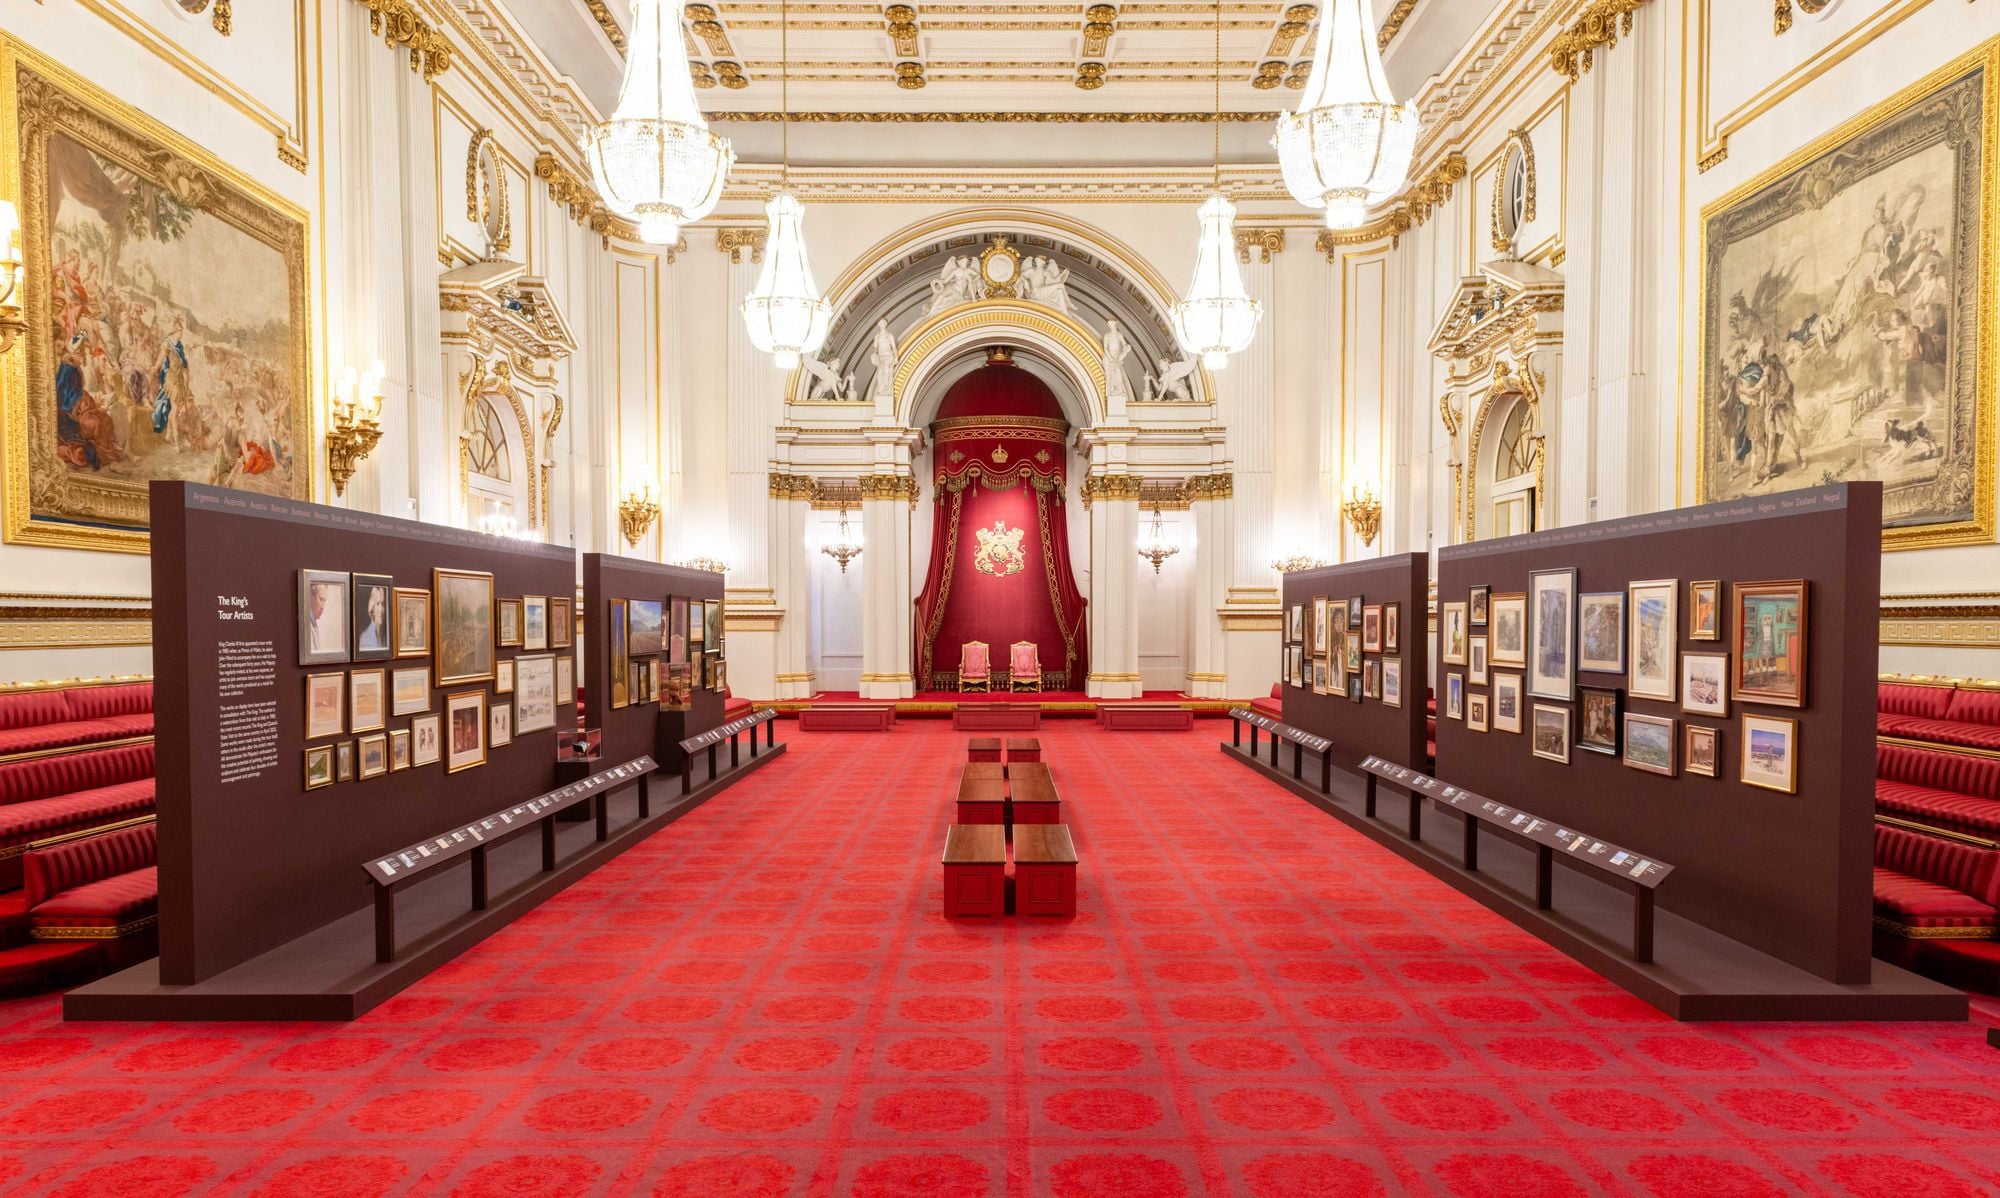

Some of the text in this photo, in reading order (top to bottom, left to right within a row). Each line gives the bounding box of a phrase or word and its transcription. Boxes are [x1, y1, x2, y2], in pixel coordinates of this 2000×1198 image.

[217, 595, 249, 609] The King's
[217, 610, 254, 620] Tour Artists
